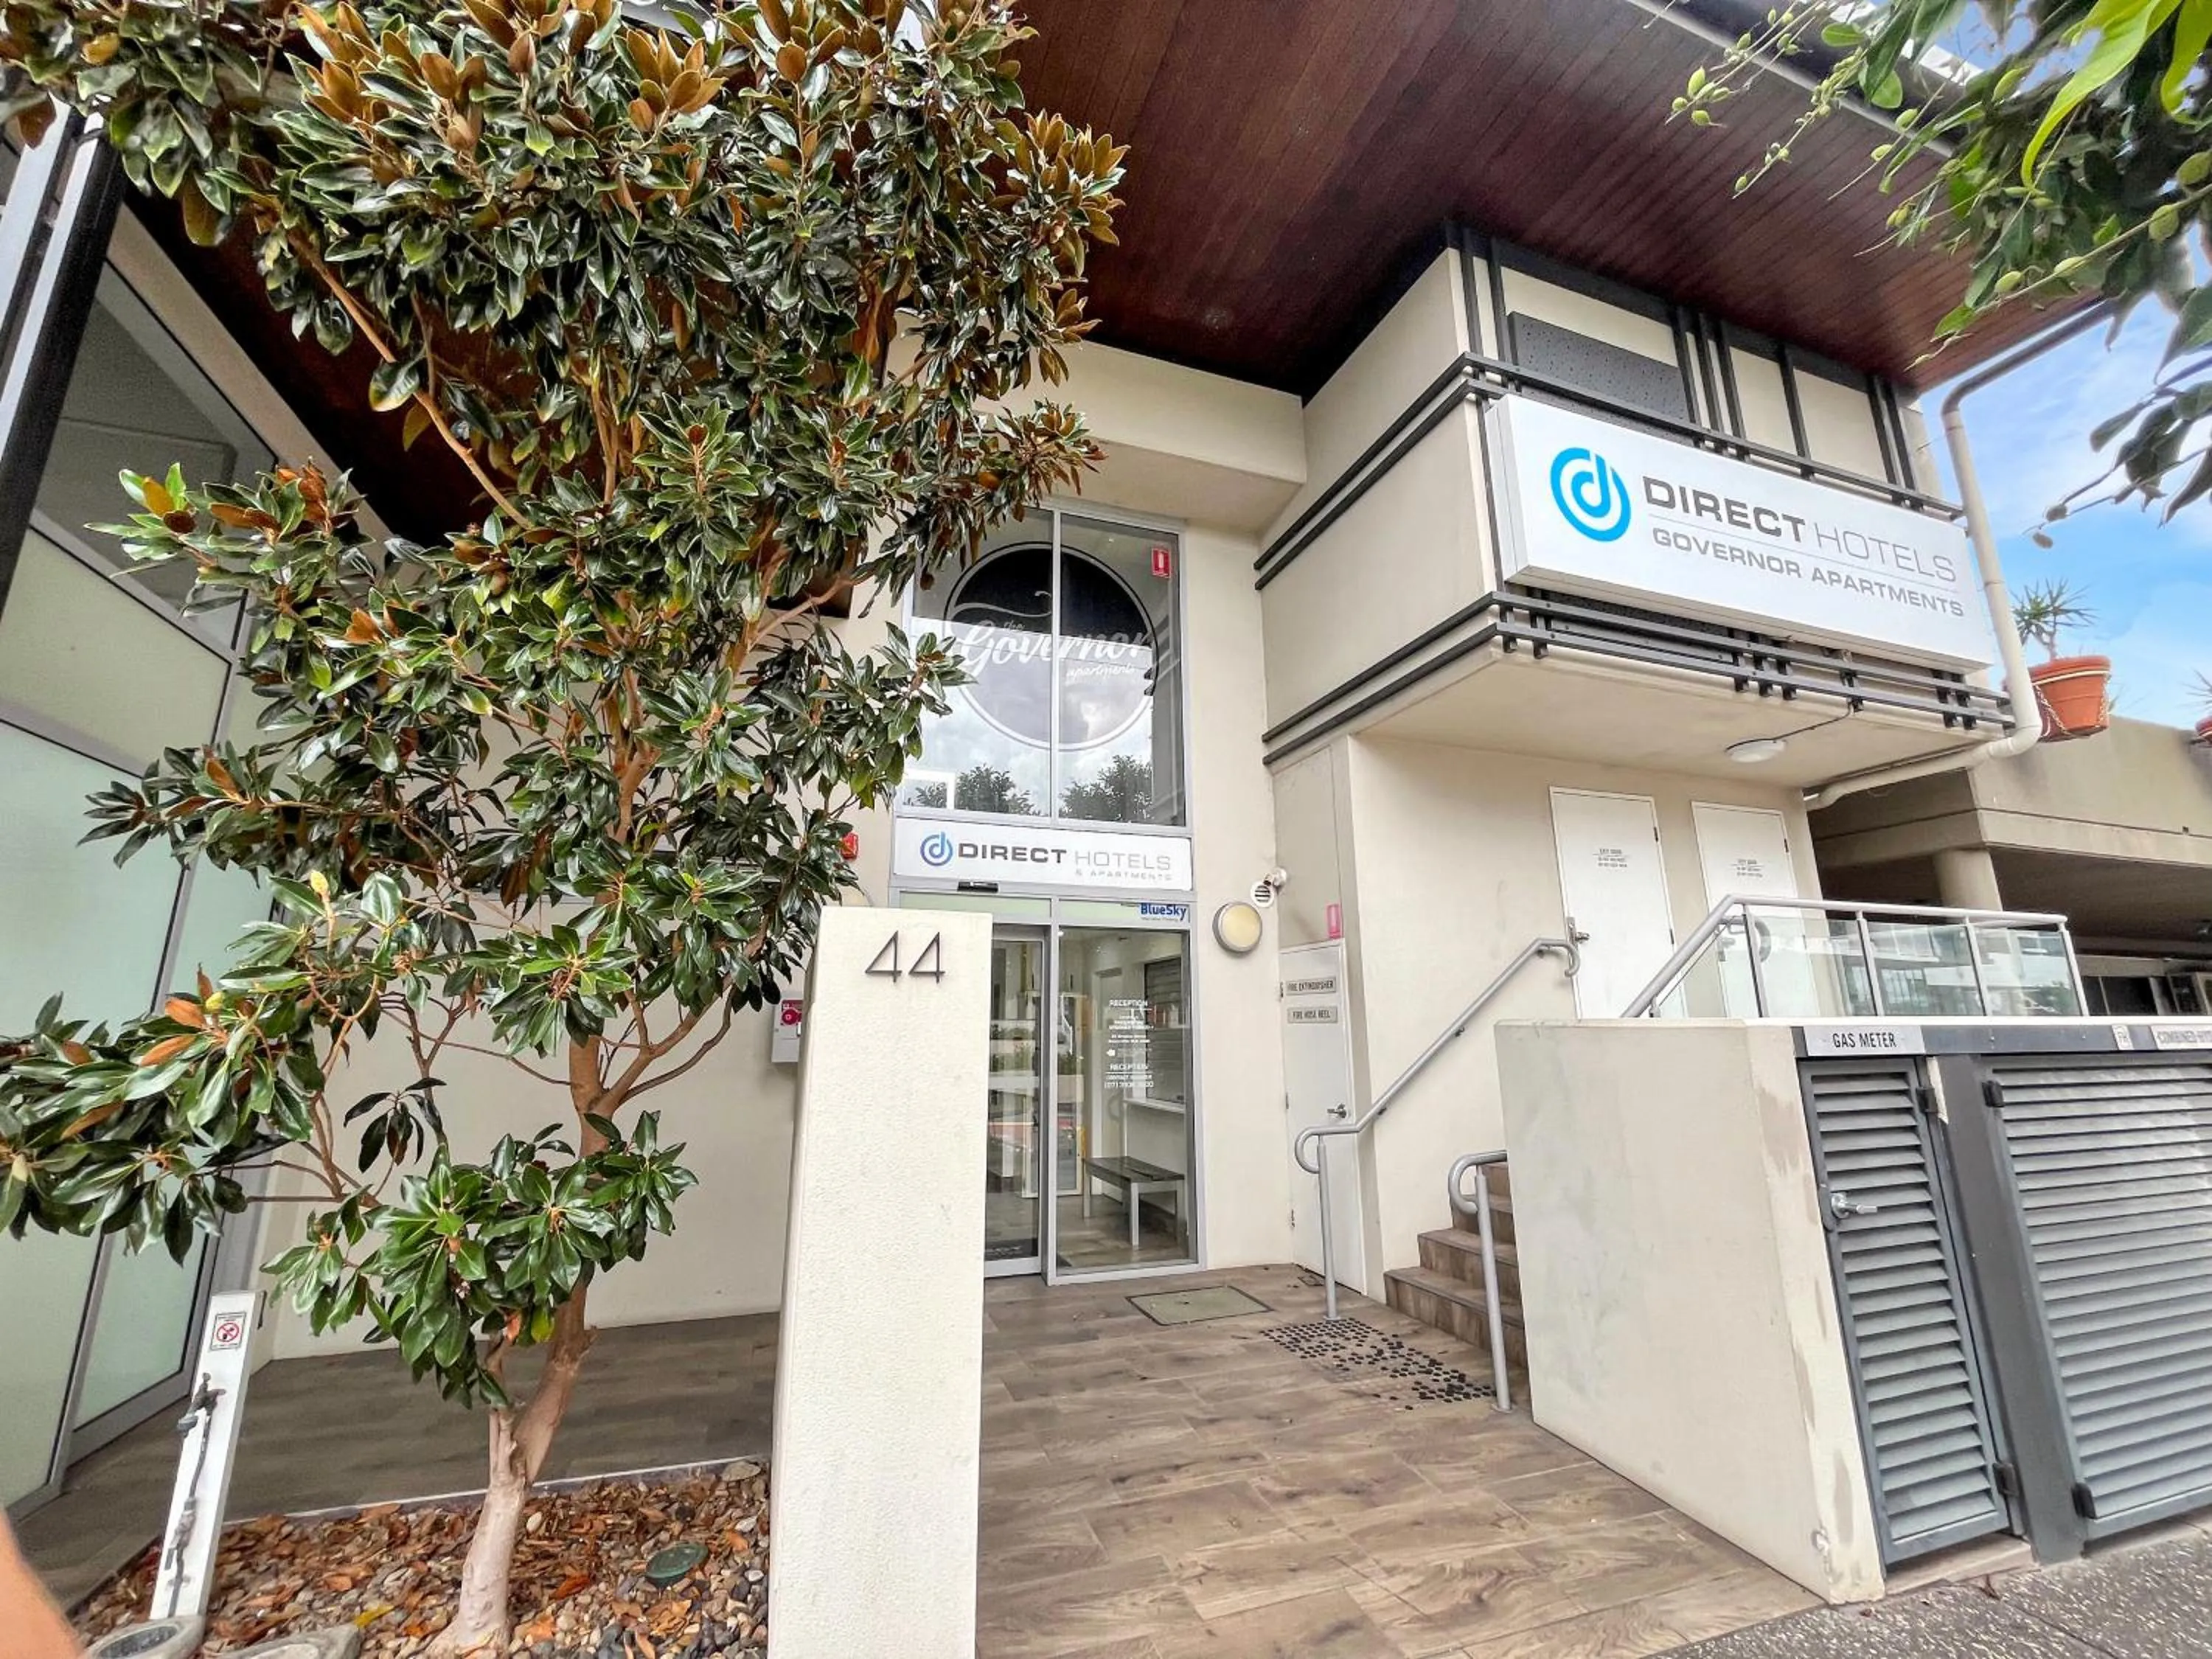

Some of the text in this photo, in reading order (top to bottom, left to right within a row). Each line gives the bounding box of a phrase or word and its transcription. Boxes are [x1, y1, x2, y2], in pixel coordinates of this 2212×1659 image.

[1643, 476, 1956, 582] DIRECT HOTELS
[1652, 527, 1964, 616] GOVERNOR APARTMENTS
[958, 843, 1171, 871] DIRECT HOTELS
[1091, 869, 1172, 880] APARTMENTS
[1141, 902, 1186, 921] BlueSky
[865, 930, 946, 984] 44
[1832, 1032, 1897, 1048] GAS METER
